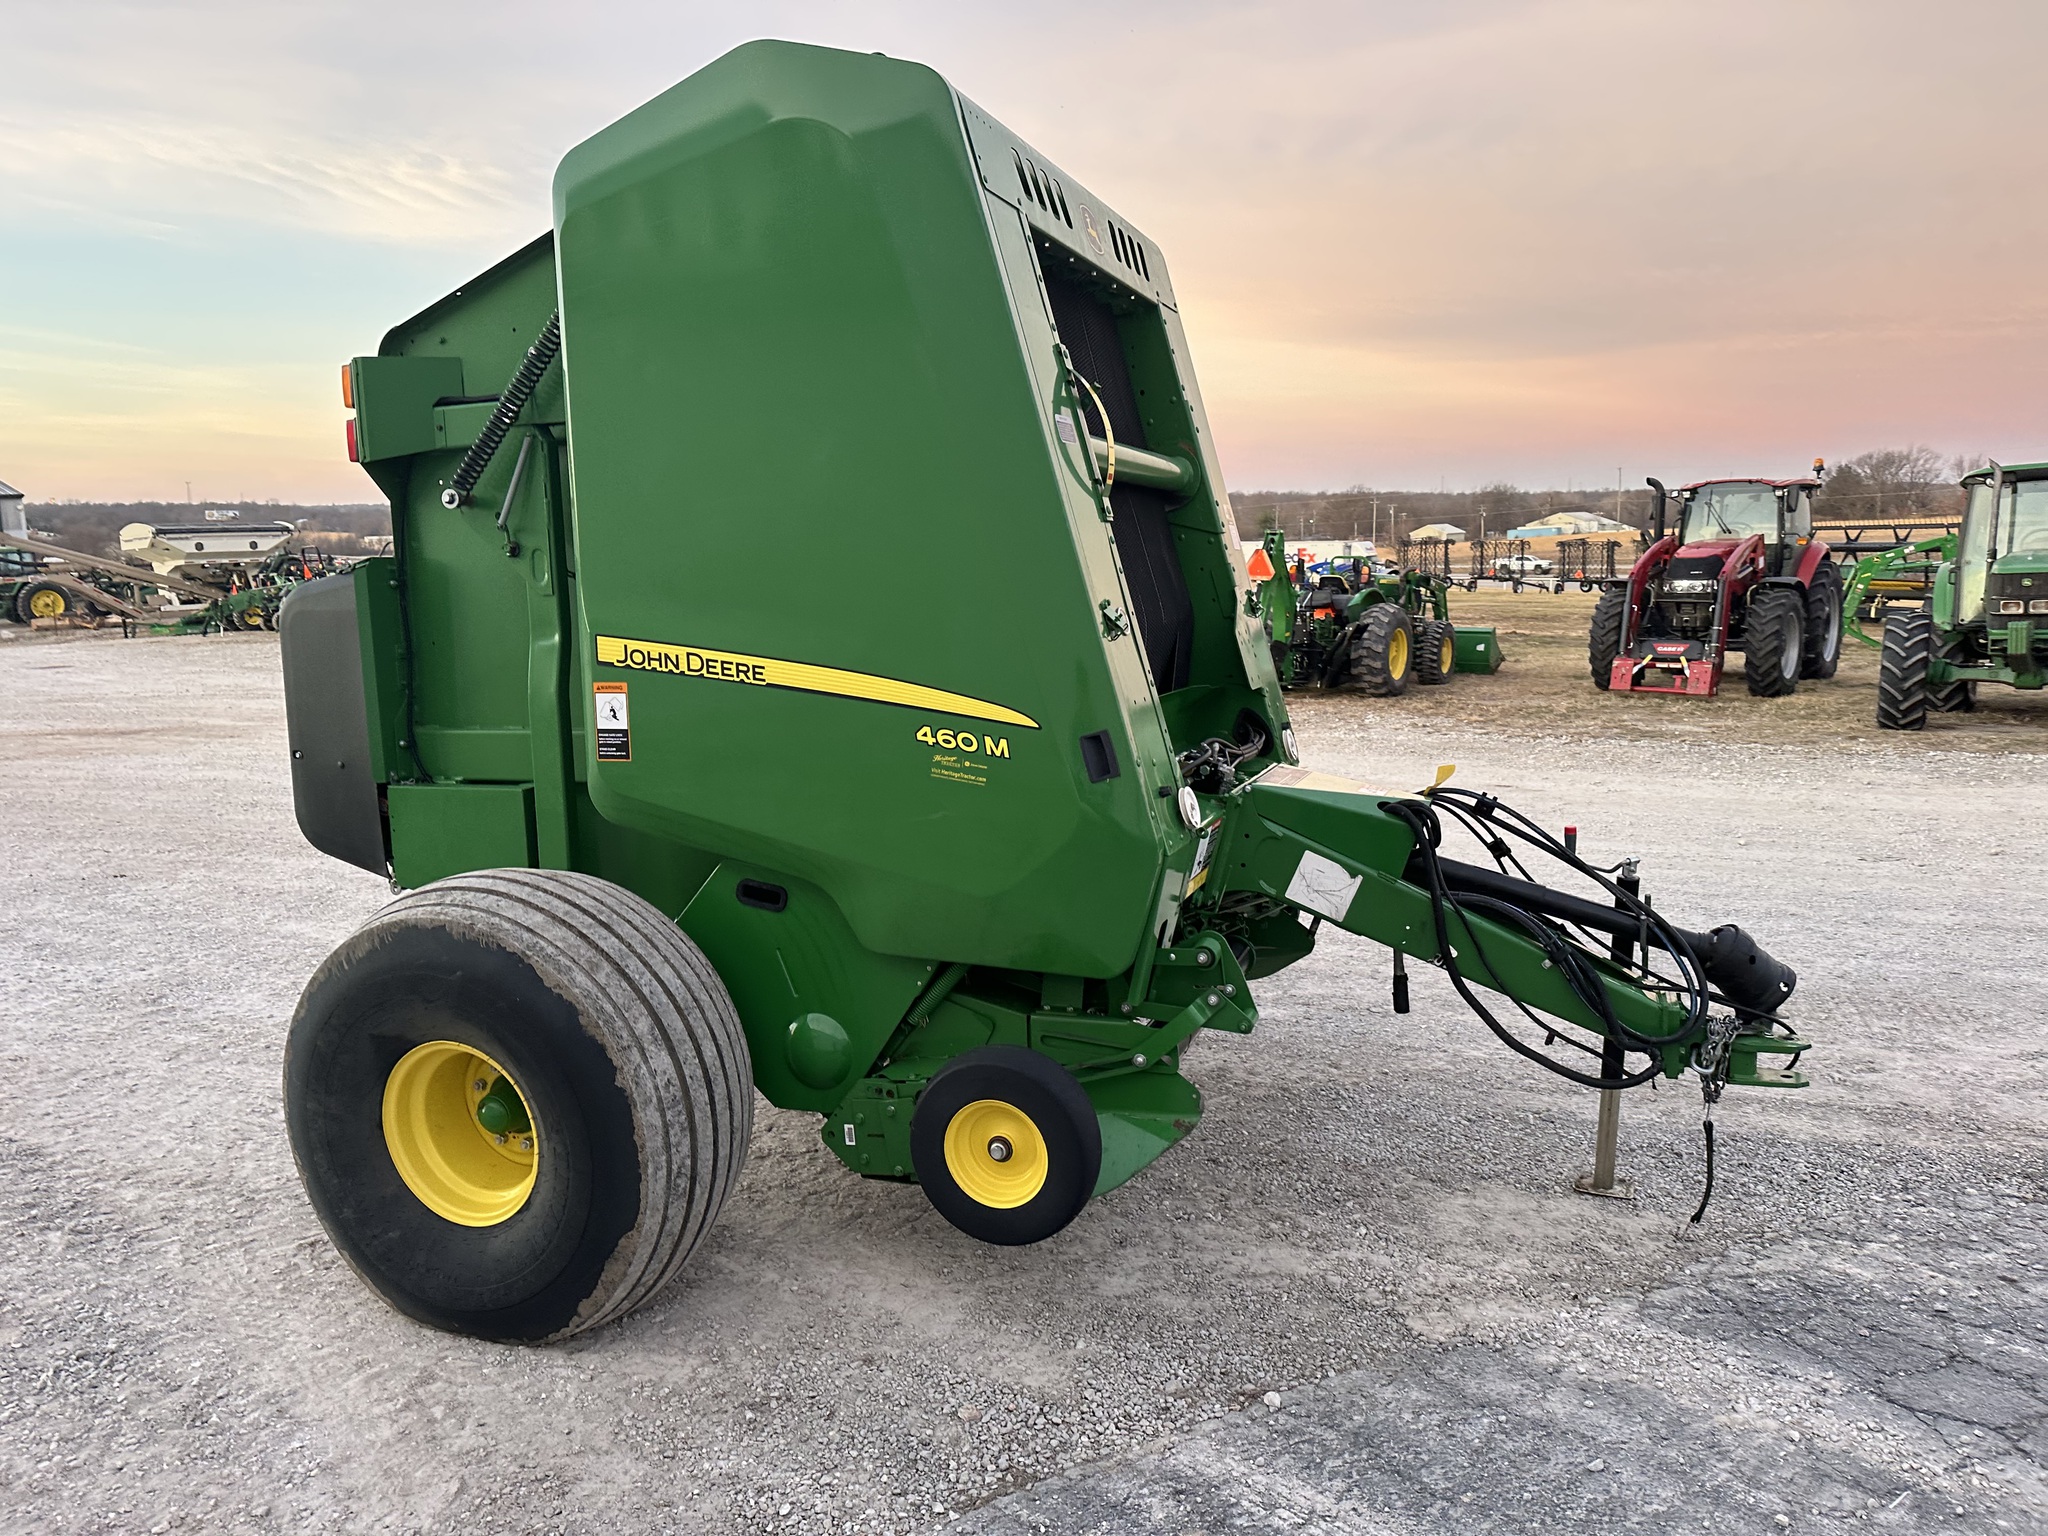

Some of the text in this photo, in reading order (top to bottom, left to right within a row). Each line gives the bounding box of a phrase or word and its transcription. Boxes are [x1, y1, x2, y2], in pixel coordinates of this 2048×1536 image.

[1284, 548, 1316, 563] edEx
[616, 644, 767, 683] JOHN DEERE
[915, 725, 1011, 759] 460 M
